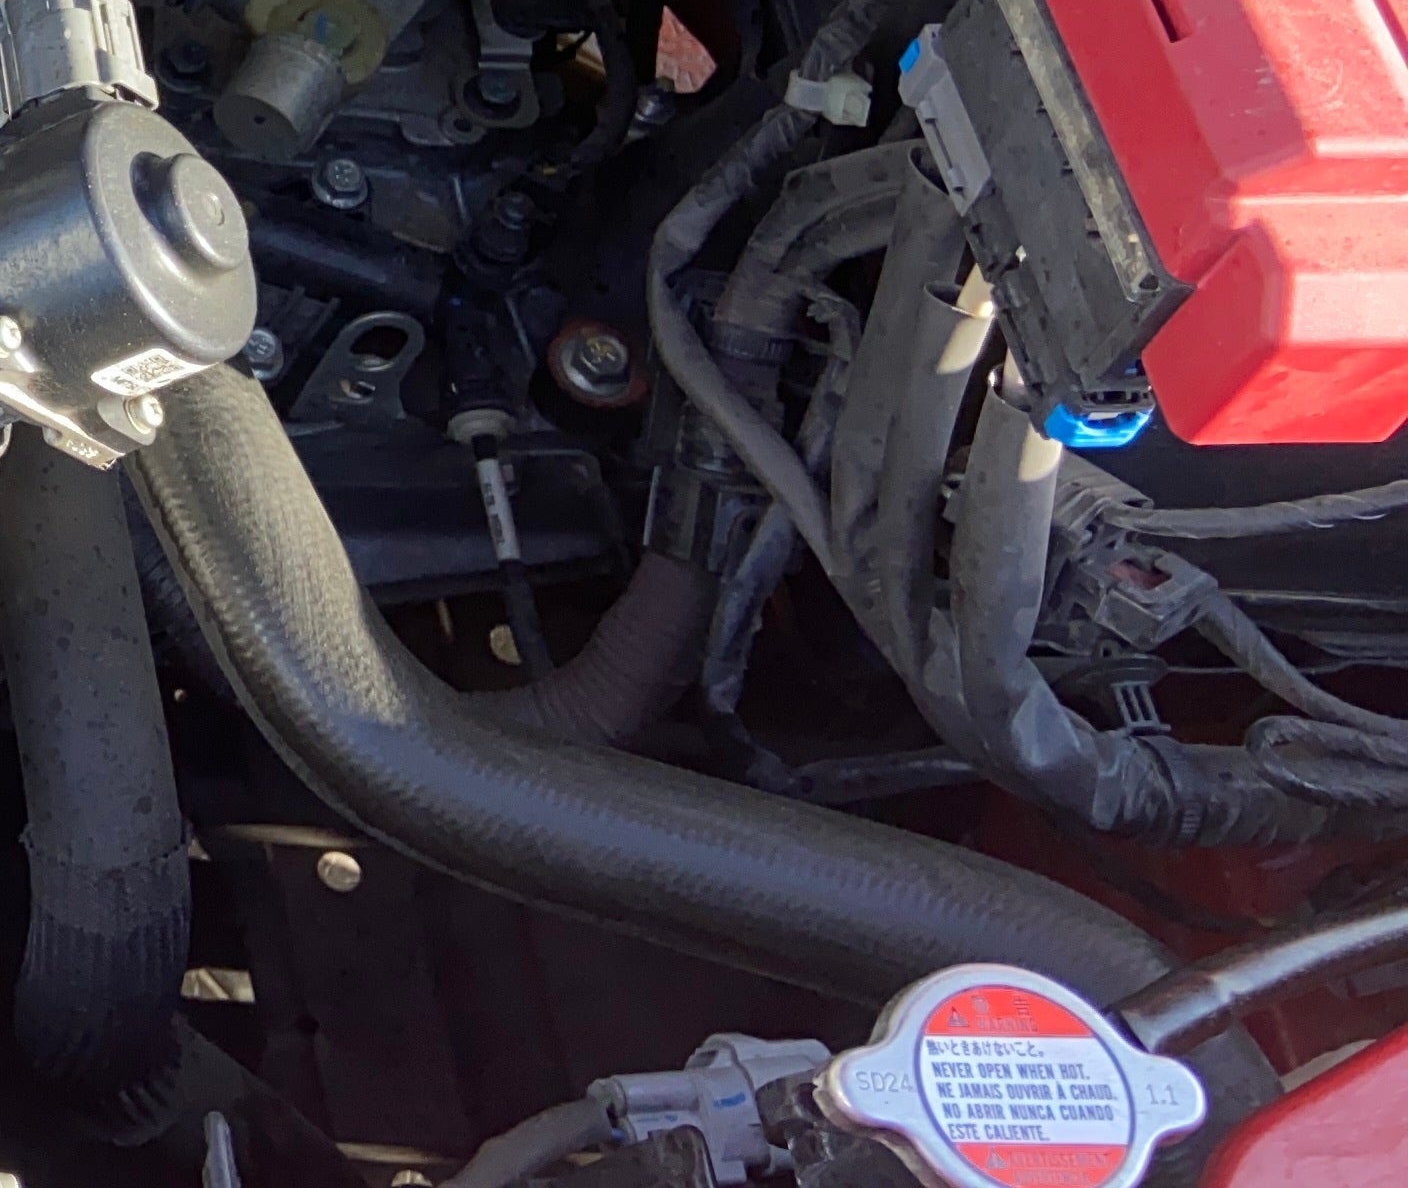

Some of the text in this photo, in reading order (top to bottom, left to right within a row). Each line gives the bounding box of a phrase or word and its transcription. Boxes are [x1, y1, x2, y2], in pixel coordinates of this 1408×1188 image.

[931, 1062, 1091, 1080] NEVER OPEN WHEN HOT.
[855, 1071, 913, 1092] SD24
[937, 1079, 1118, 1101] NE JAMAIS OUVRIR À CHAUD.
[942, 1103, 1114, 1121] NO ABRIR NUNCA CUANDO
[948, 1124, 1051, 1141] ESTE CALIENTE.
